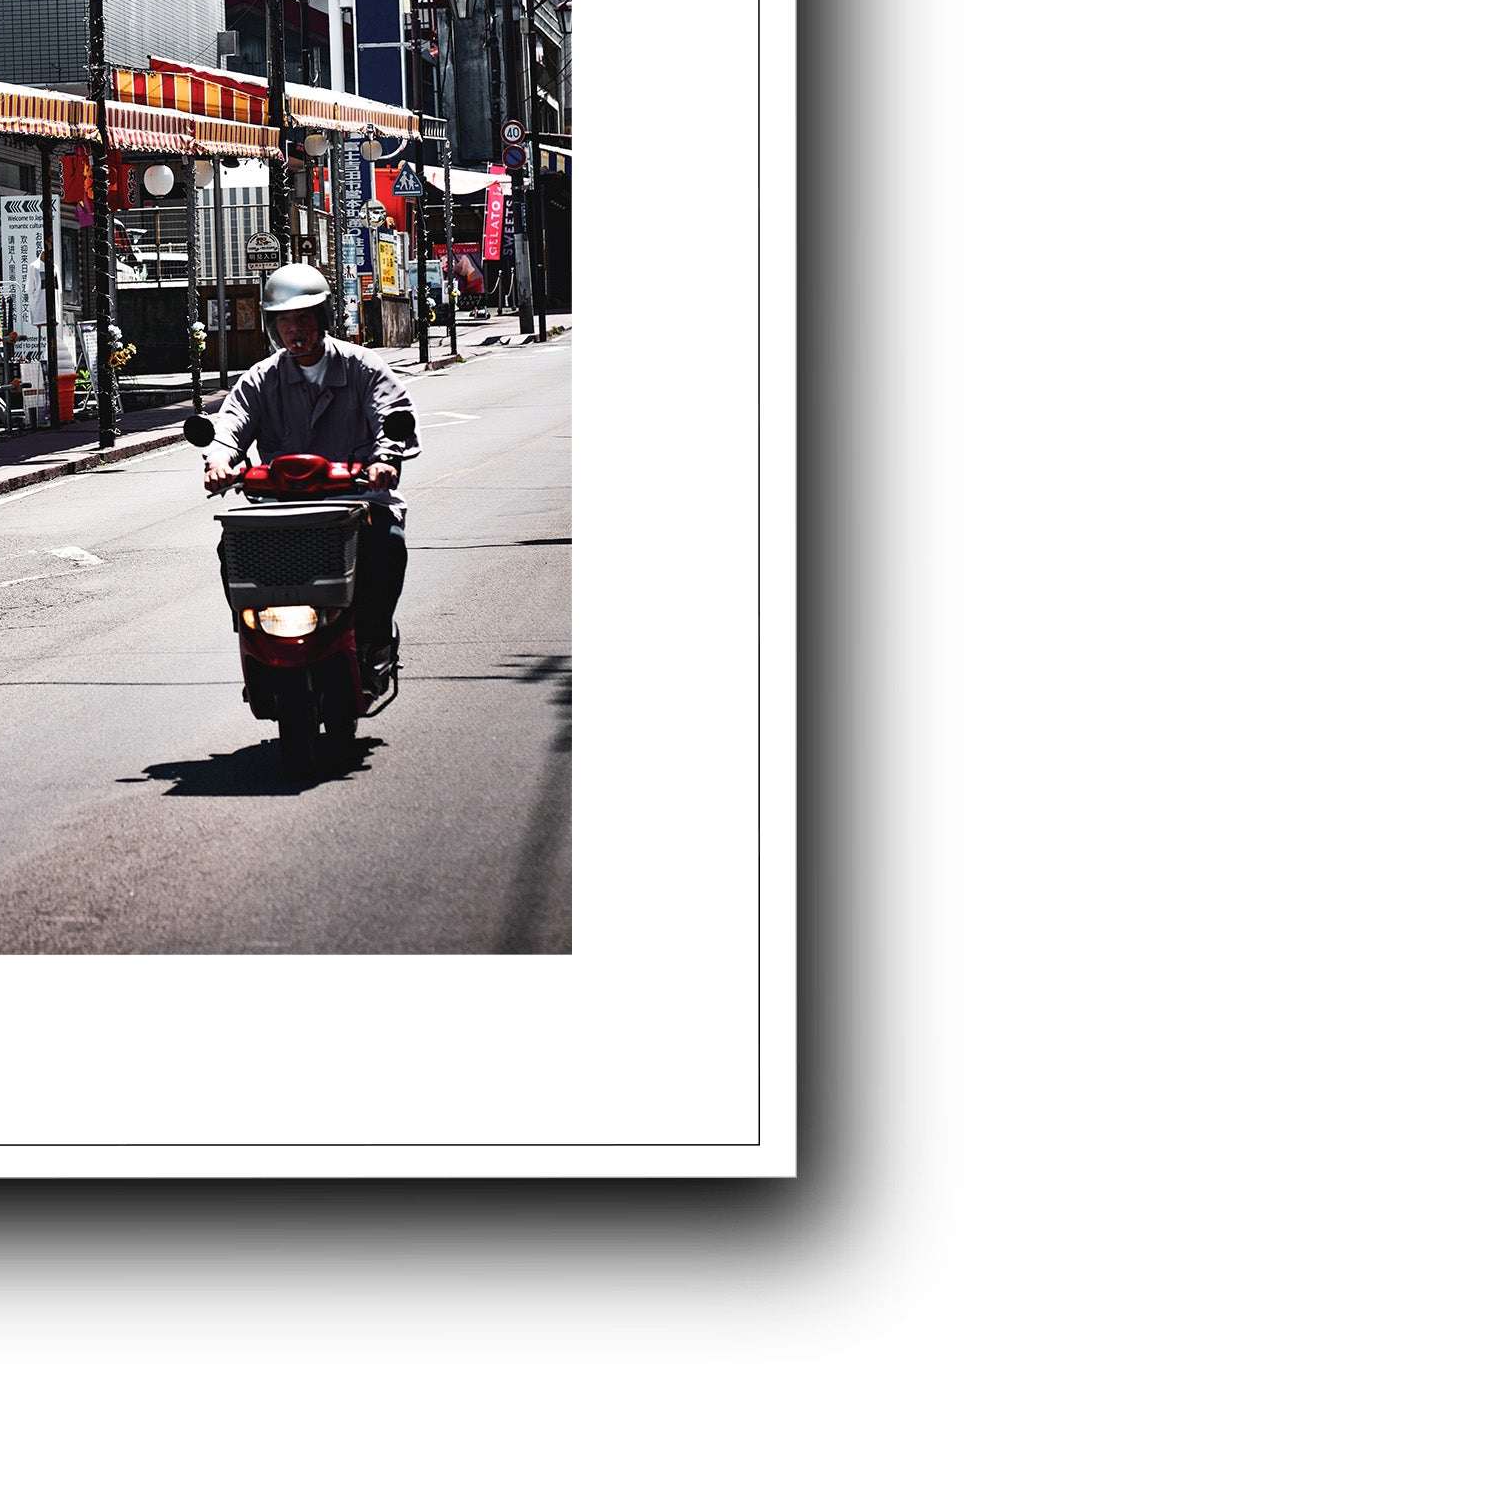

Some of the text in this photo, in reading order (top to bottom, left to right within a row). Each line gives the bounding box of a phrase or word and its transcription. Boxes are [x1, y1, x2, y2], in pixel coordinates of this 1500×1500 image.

[506, 127, 520, 138] 40
[488, 200, 501, 256] GELATO
[503, 200, 515, 256] SWEETS
